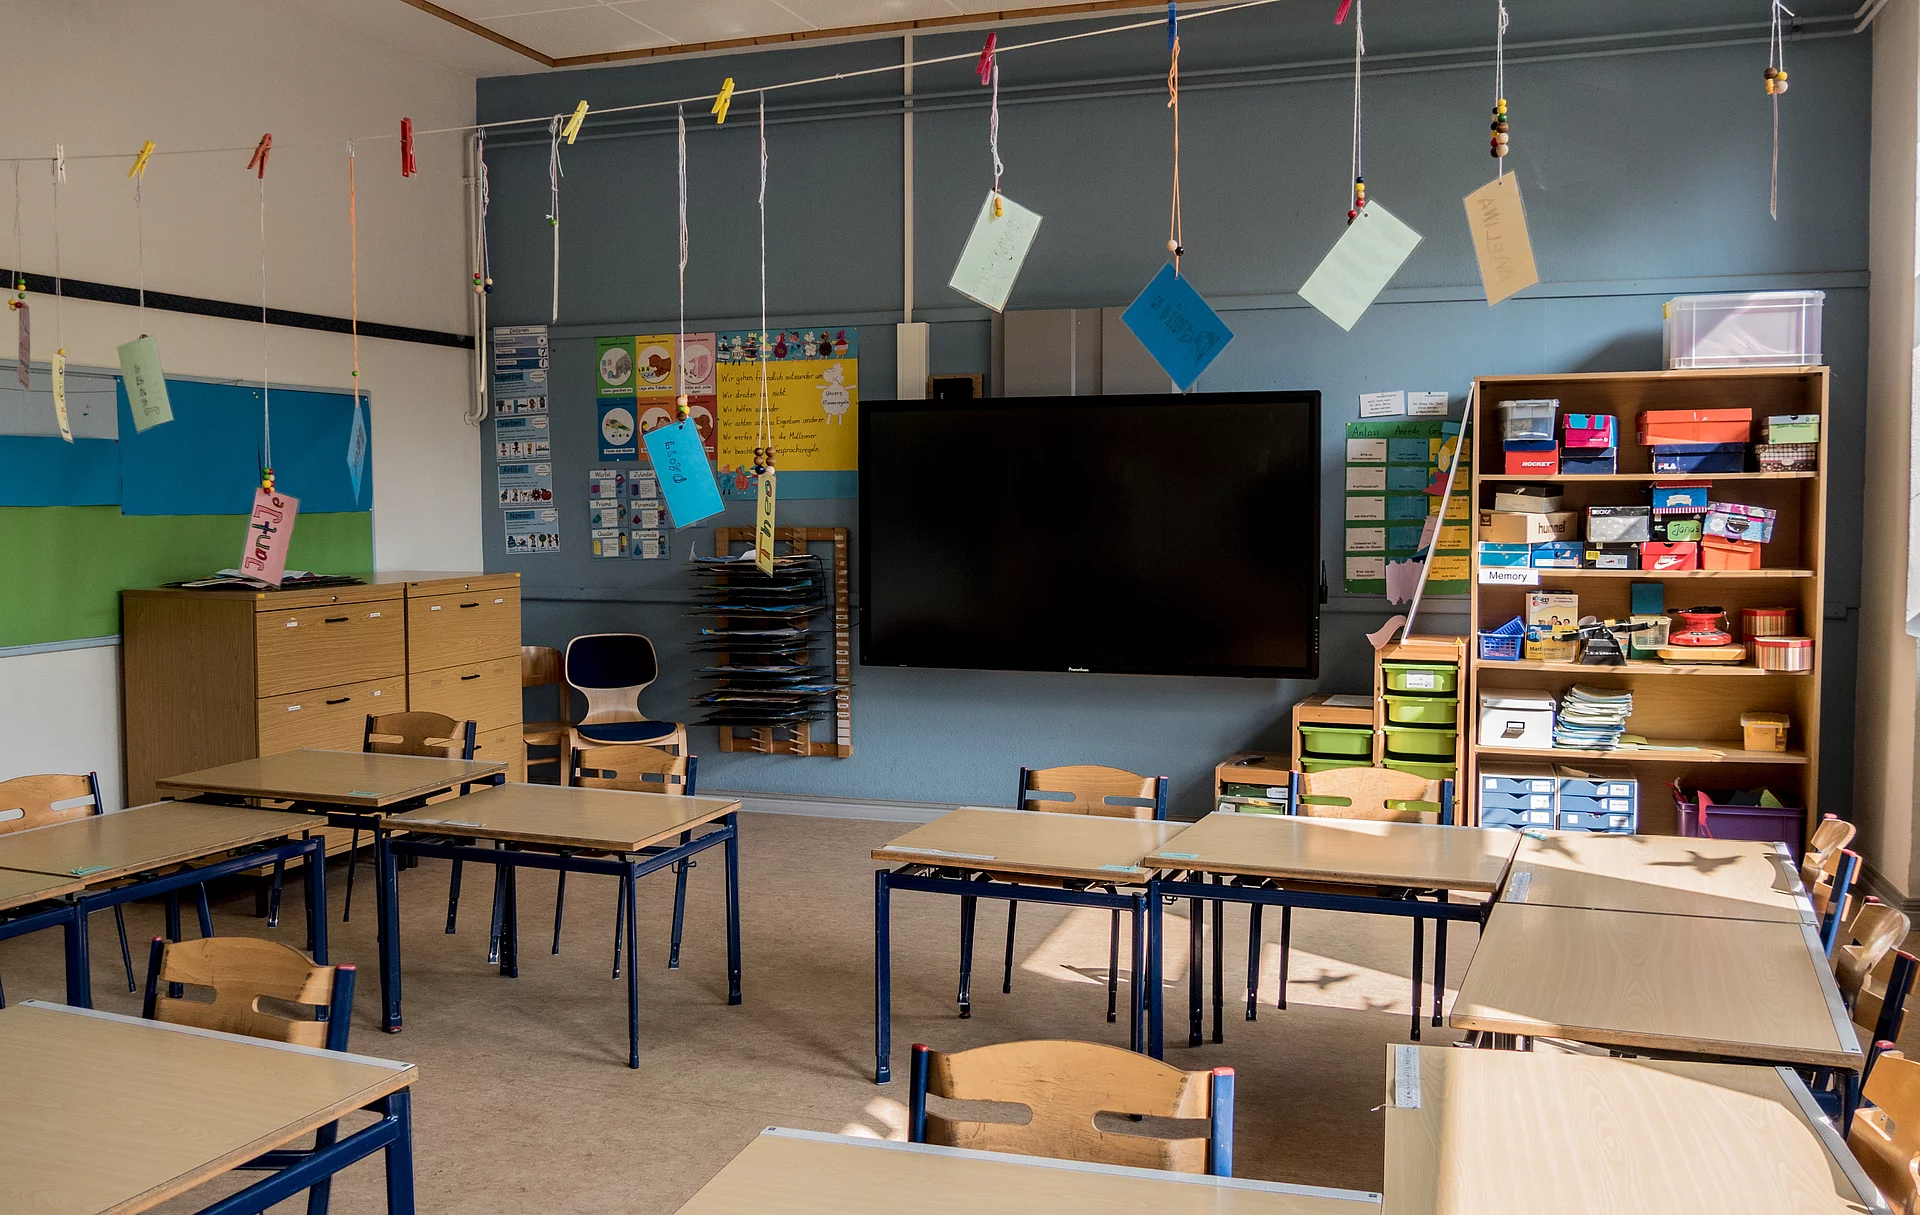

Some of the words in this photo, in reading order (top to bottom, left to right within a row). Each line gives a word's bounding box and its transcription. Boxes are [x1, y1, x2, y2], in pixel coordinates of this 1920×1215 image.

[721, 374, 734, 382] Wir
[735, 388, 756, 398] streiten
[735, 418, 752, 426] achten
[776, 416, 800, 428] Eigentum
[735, 432, 752, 440] werfen
[1352, 426, 1380, 437] Anlass
[1394, 424, 1420, 435] Anrede
[1538, 520, 1566, 534] hummel
[1672, 524, 1700, 536] Jonas
[1489, 571, 1528, 582] Memory
